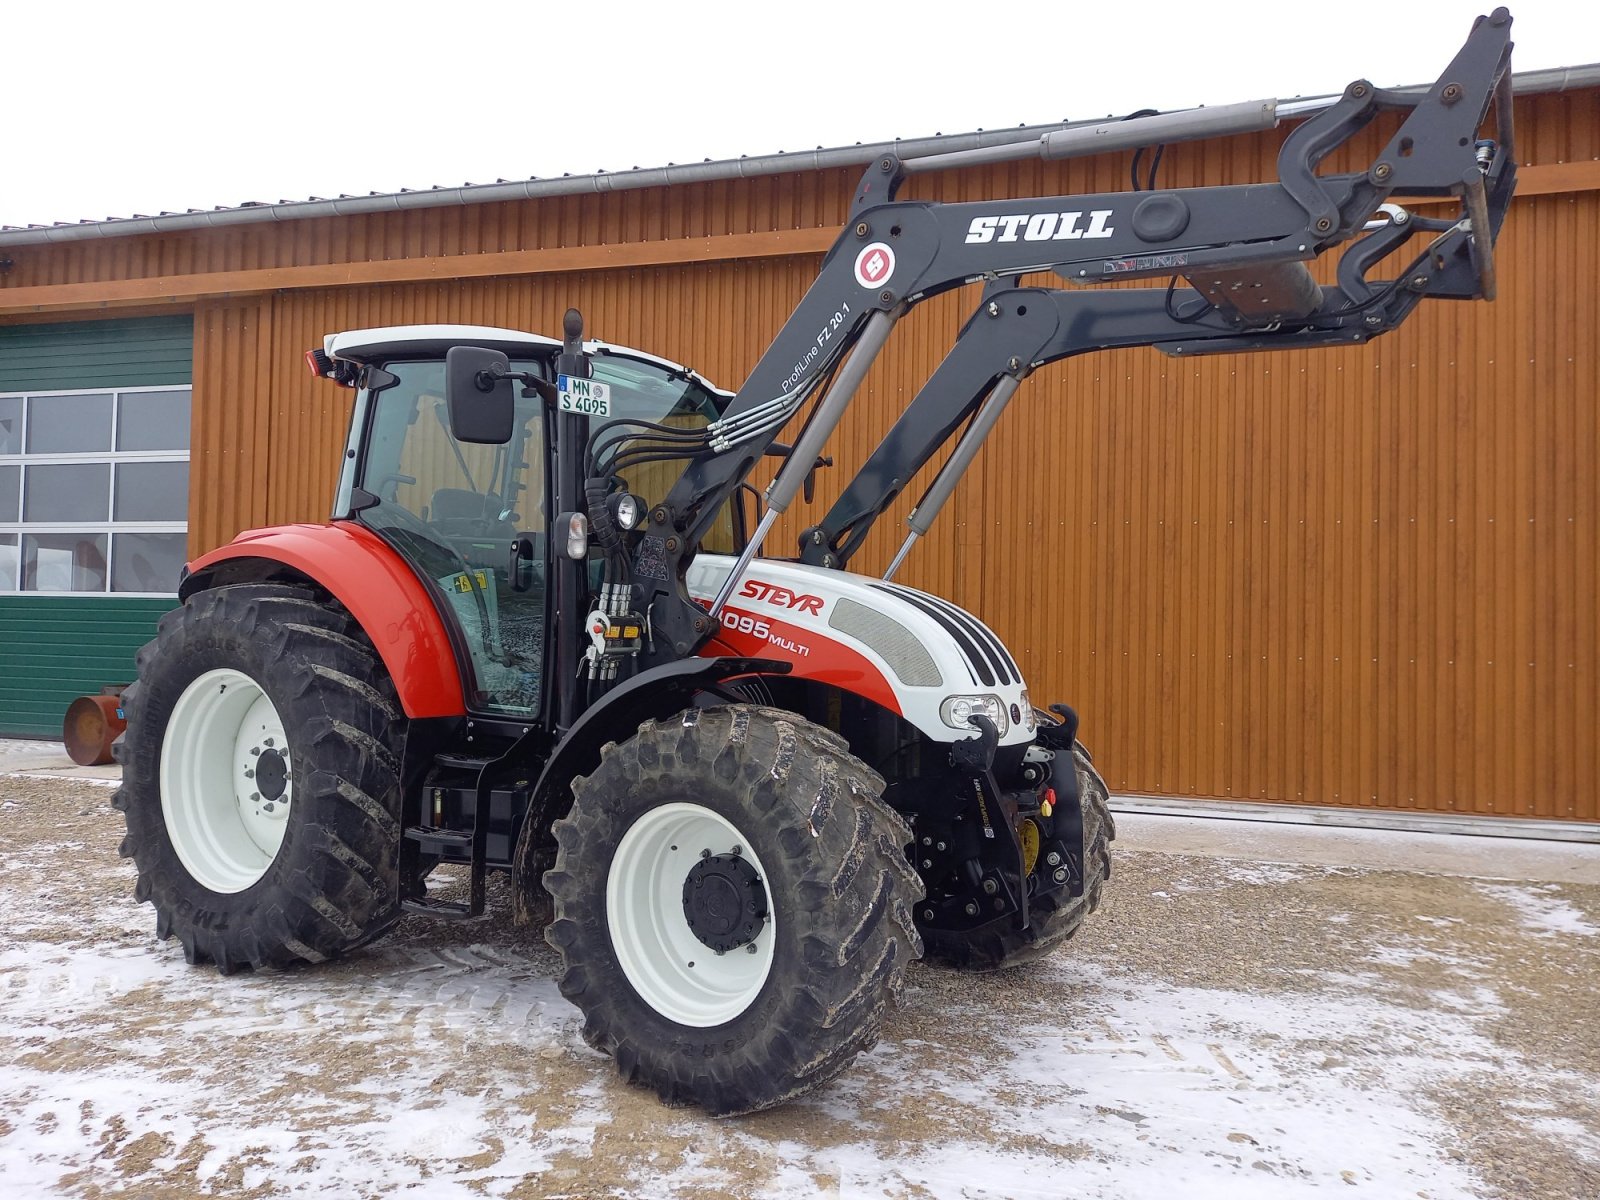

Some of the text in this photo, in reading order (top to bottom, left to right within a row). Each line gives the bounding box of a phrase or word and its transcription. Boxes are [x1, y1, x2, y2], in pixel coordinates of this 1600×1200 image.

[964, 209, 1115, 244] STOLL
[781, 301, 851, 393] ProfiLine FZ 20.1
[563, 394, 607, 415] S 4095
[572, 379, 590, 396] MN
[738, 579, 825, 617] STEYR
[718, 609, 810, 657] 095 MULTI
